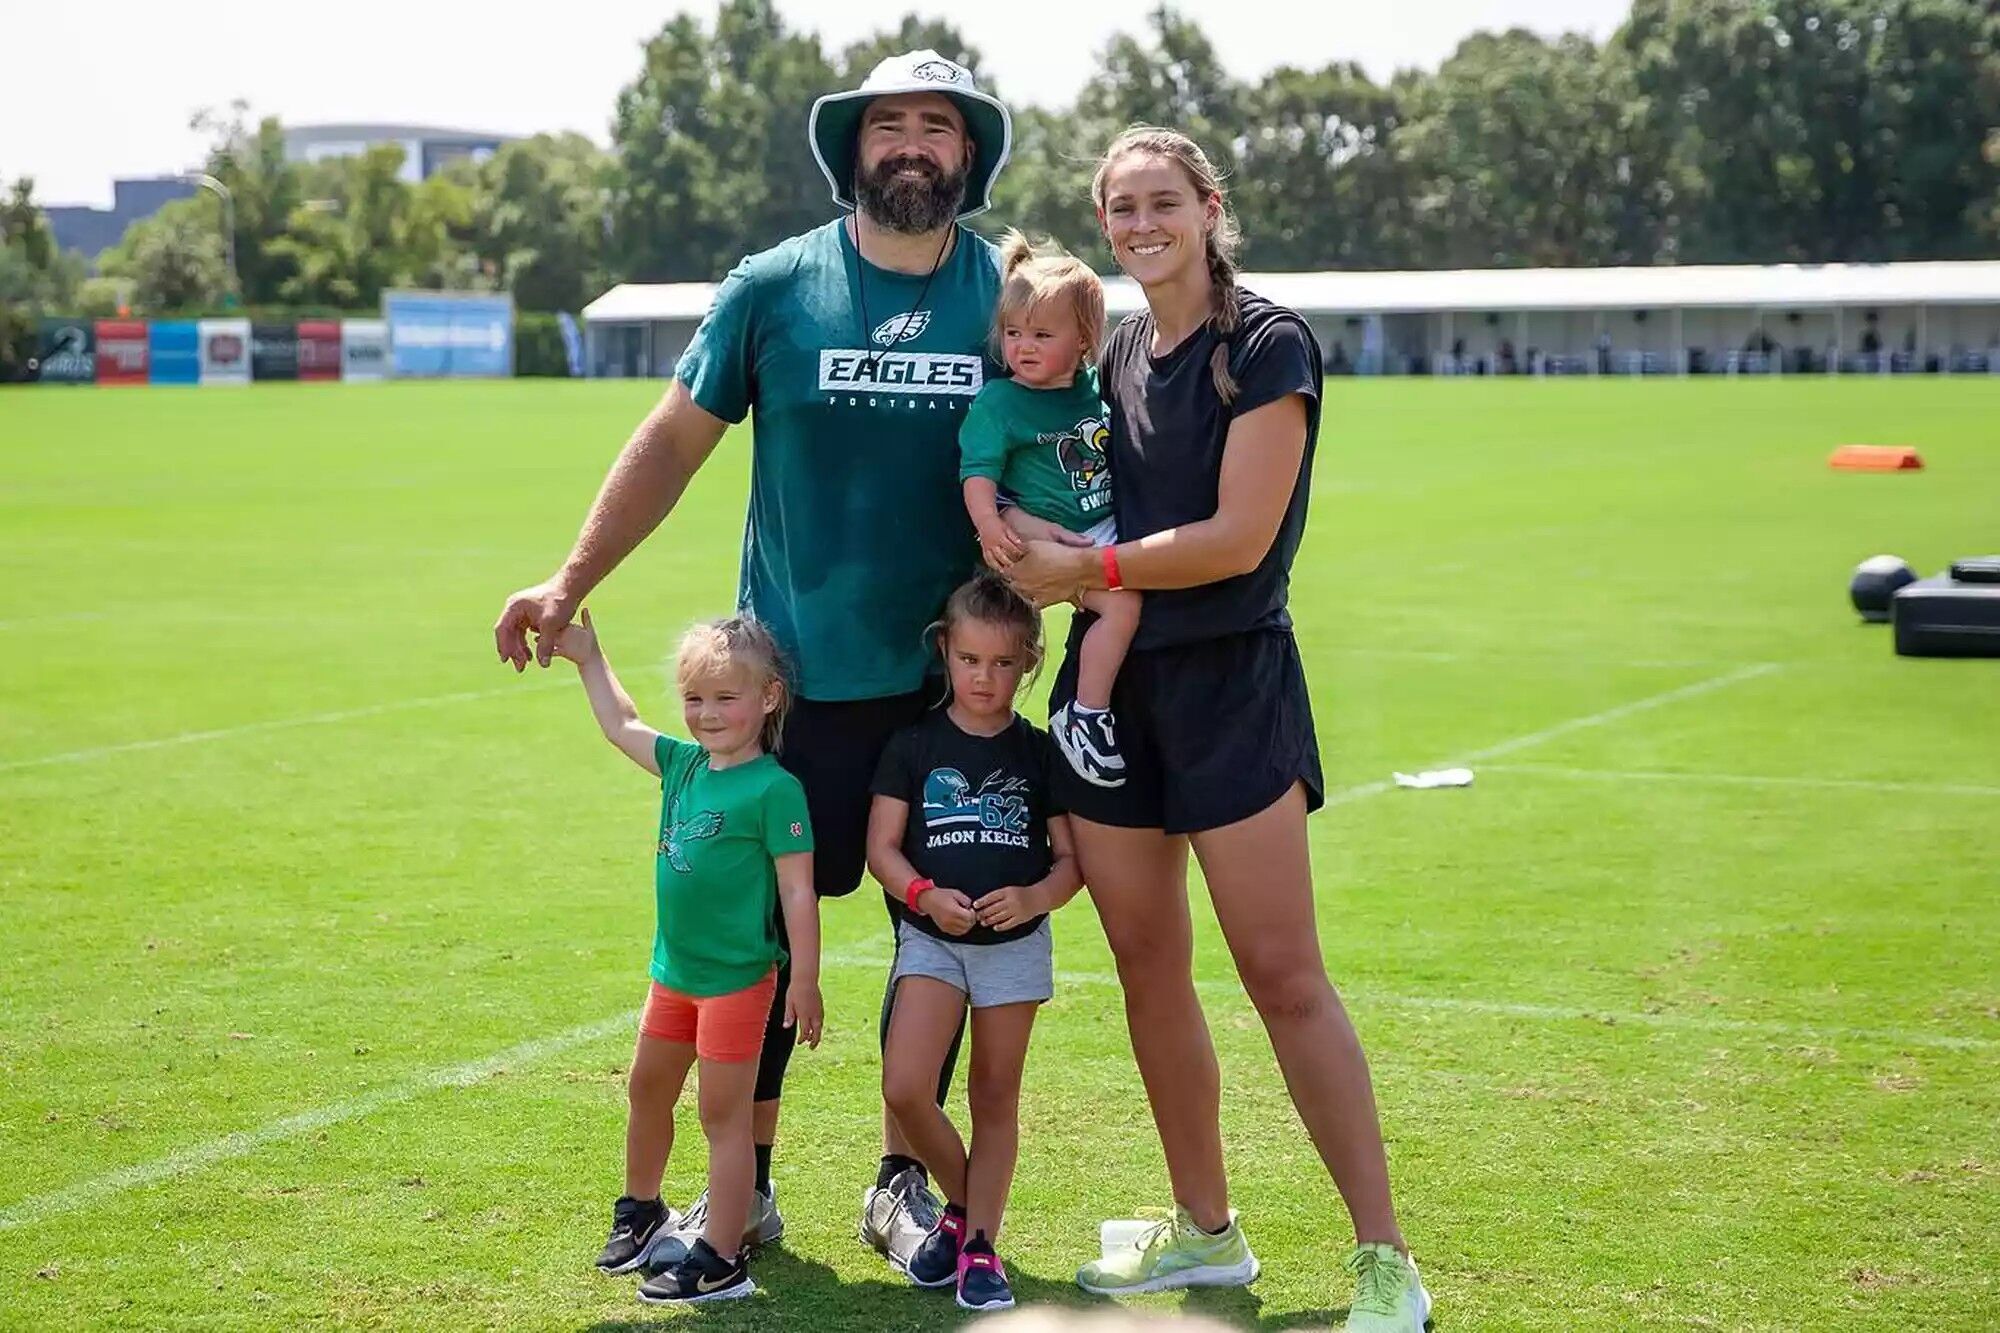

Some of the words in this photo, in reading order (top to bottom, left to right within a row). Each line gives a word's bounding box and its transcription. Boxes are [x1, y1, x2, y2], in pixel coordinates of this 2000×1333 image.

[828, 357, 974, 386] EAGLES
[979, 793, 1025, 834] 62
[926, 830, 975, 848] JASON
[980, 830, 1030, 848] KELCE
